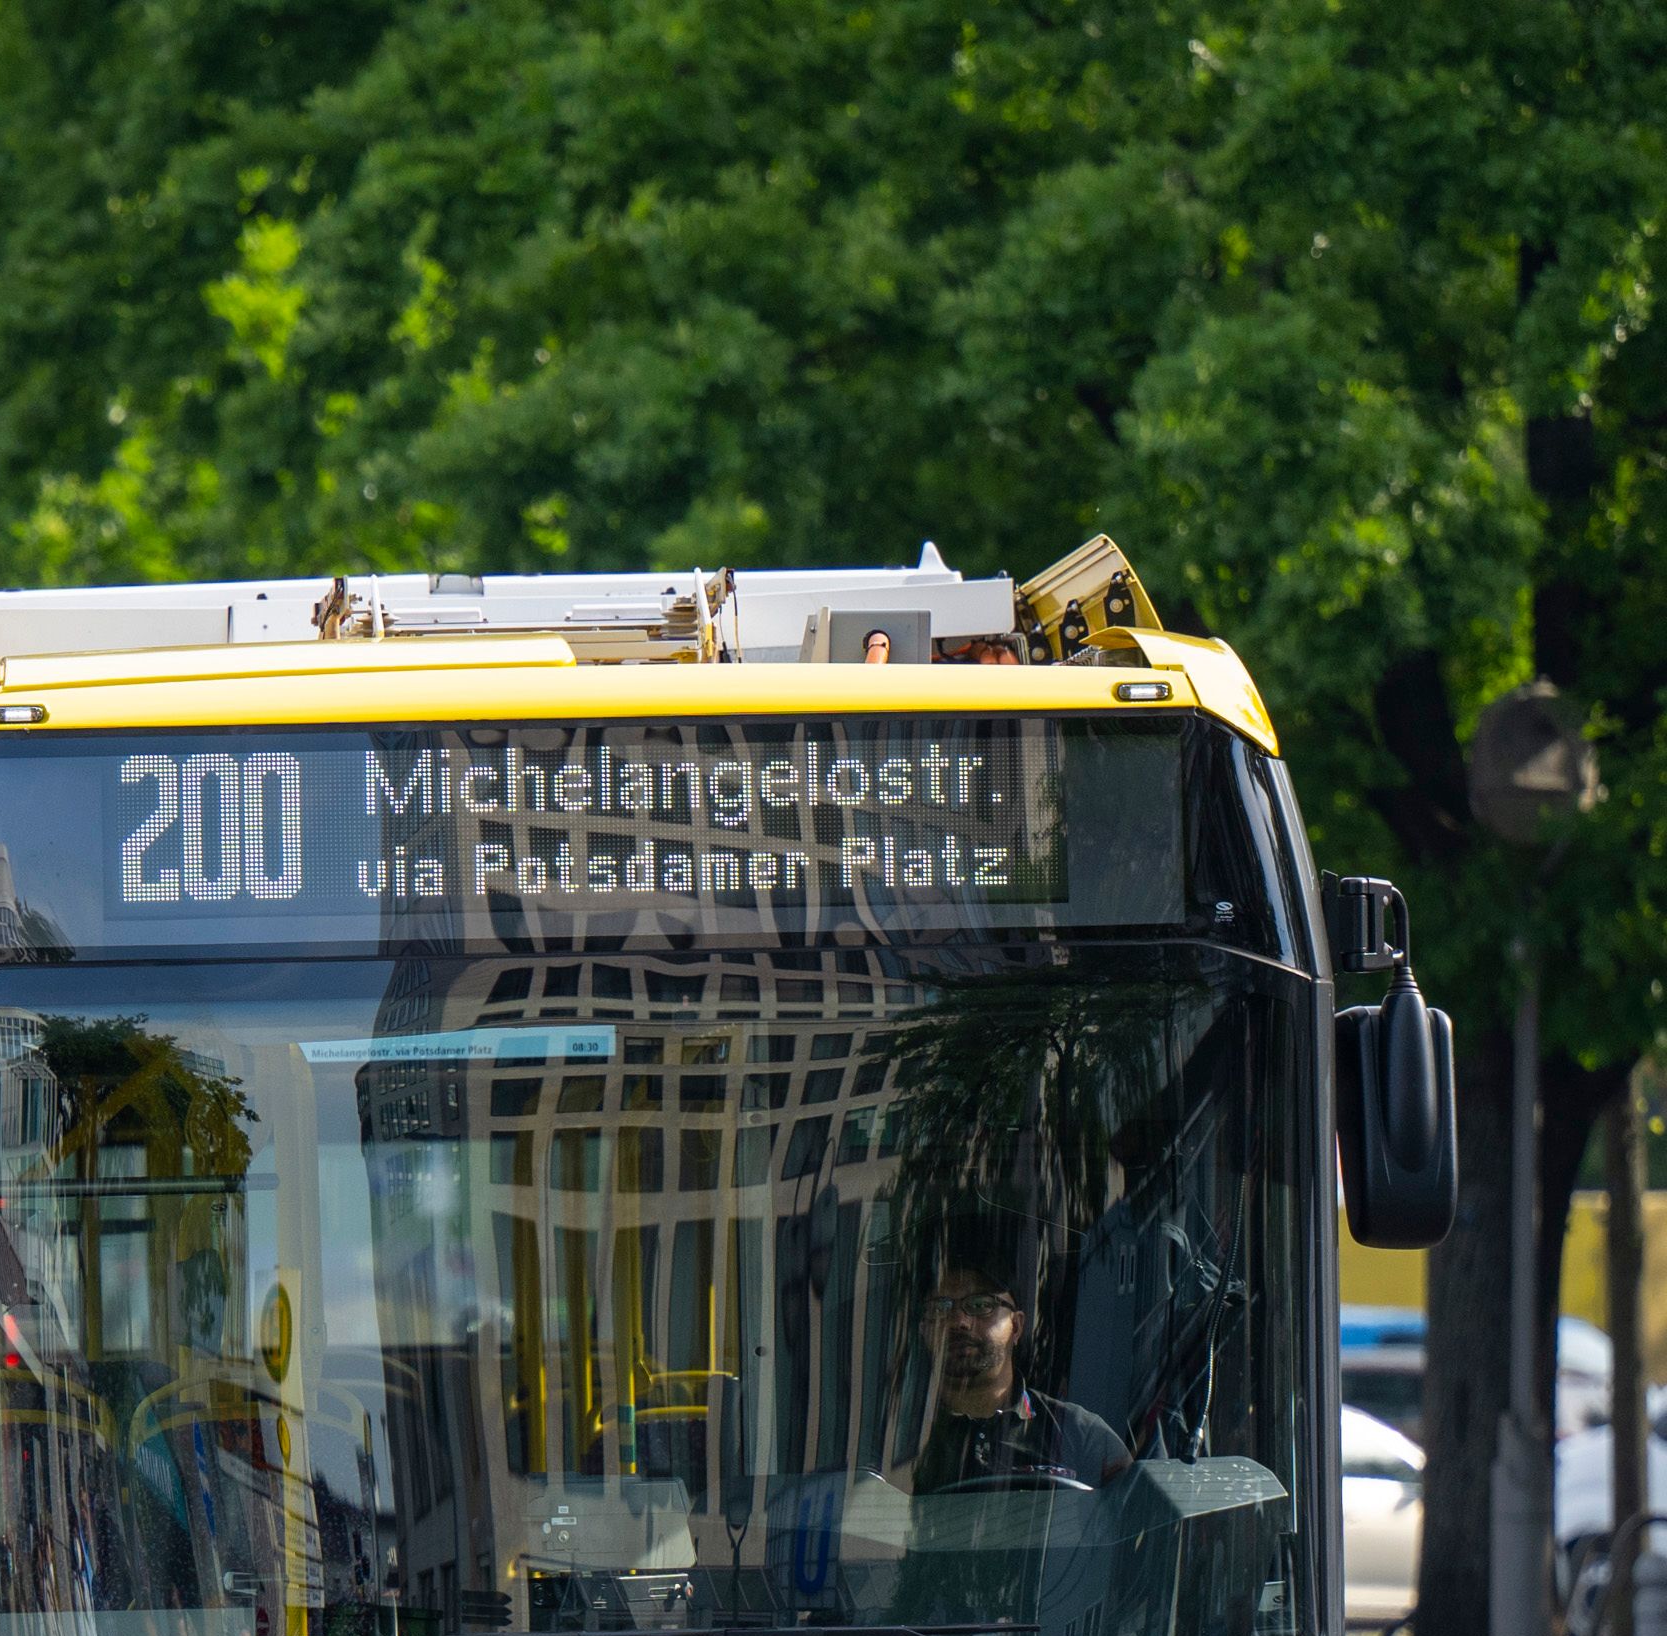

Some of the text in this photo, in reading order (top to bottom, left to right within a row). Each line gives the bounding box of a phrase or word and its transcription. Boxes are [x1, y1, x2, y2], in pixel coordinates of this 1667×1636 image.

[119, 741, 1006, 903] 200 Michelangelostr.
[357, 835, 1010, 898] via Potsdamer Platz
[311, 1047, 394, 1059] Michelangelostr.
[395, 1047, 410, 1056] via
[413, 1045, 465, 1056] Potsdamer
[468, 1044, 492, 1055] Platz
